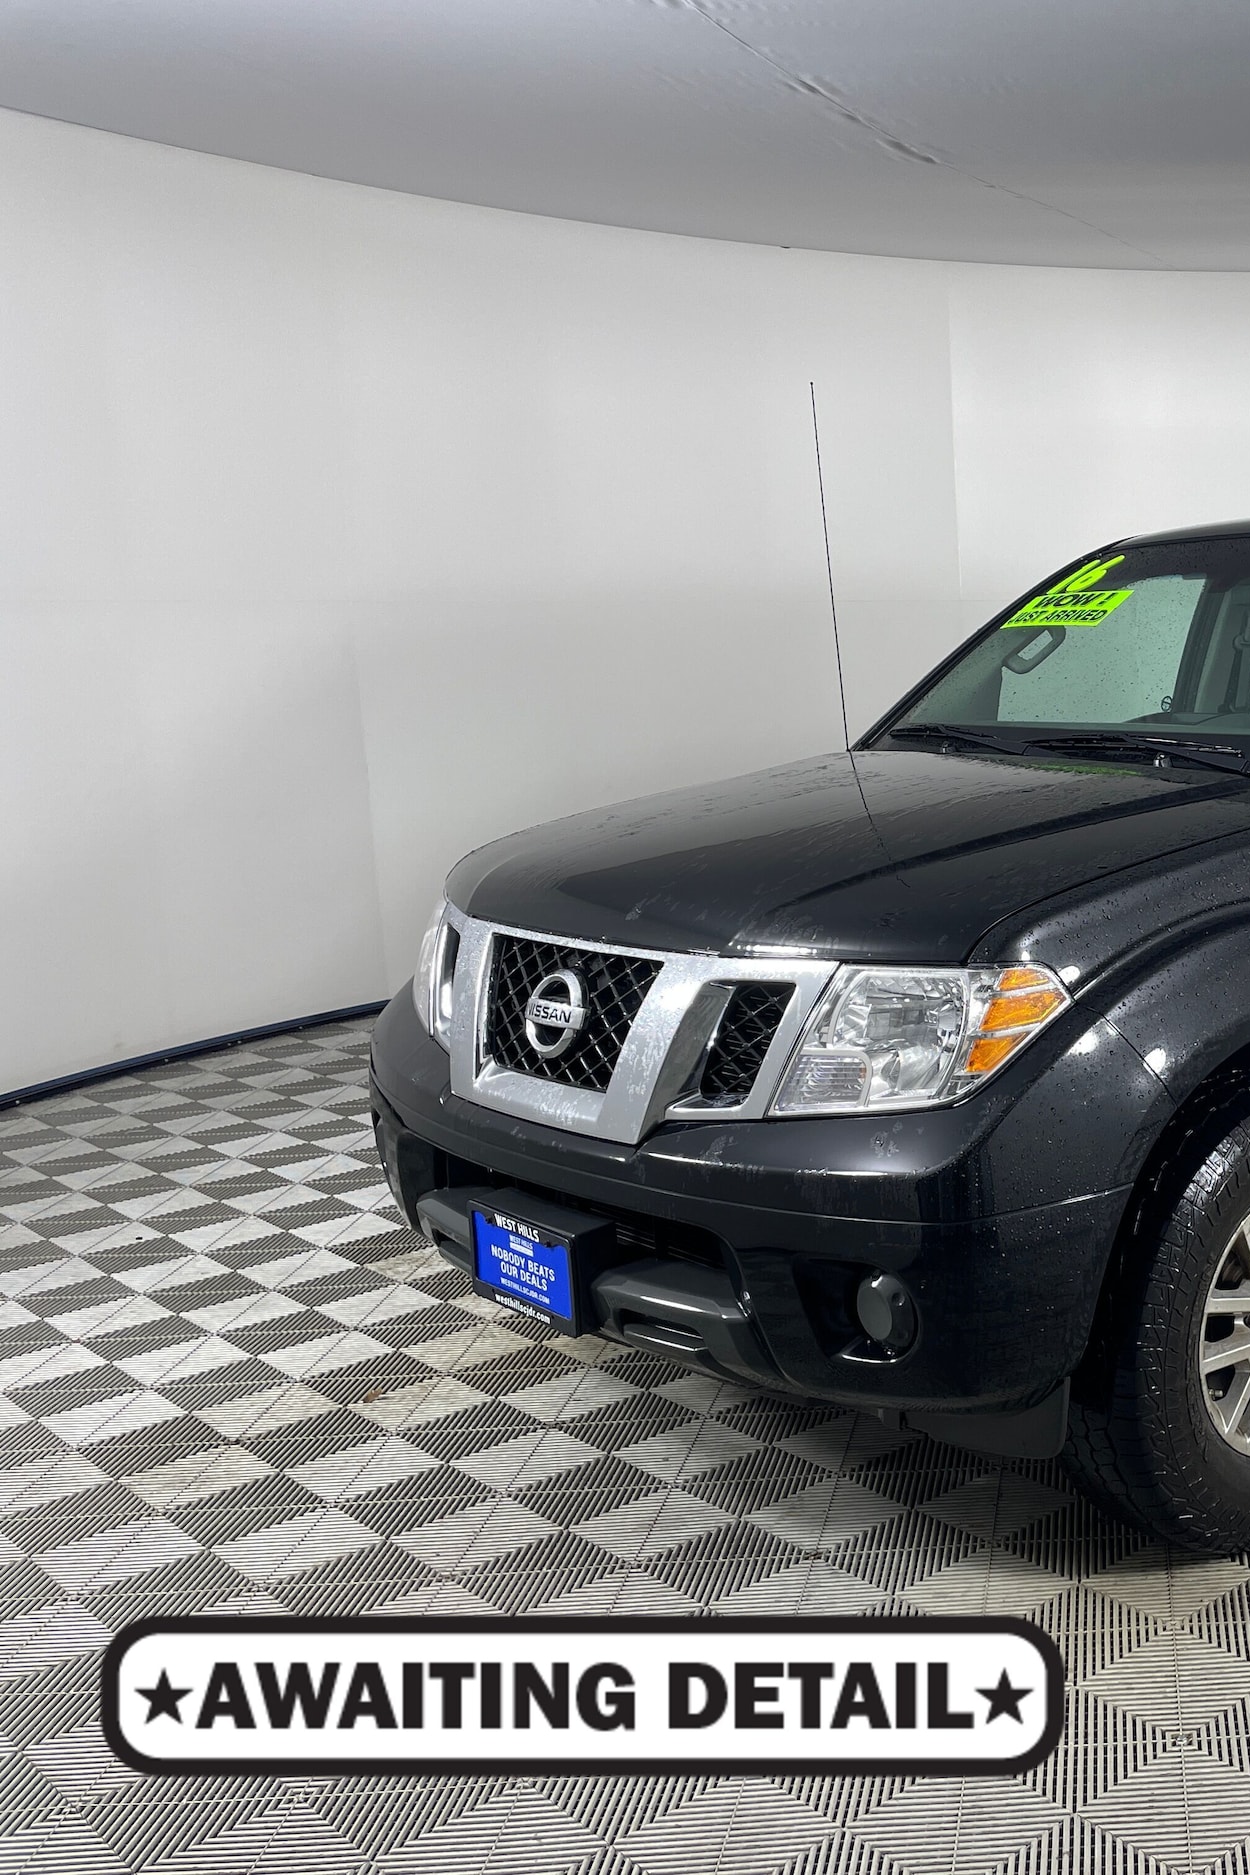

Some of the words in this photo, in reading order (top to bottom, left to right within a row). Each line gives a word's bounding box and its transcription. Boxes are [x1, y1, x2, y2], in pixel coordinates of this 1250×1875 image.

[1046, 554, 1126, 595] 16
[1007, 610, 1050, 625] JUST
[1041, 609, 1108, 622] ARRIVED
[528, 1003, 572, 1024] NISSAN
[494, 1213, 516, 1232] WEST
[516, 1222, 540, 1243] HILLS
[509, 1234, 521, 1246] WEST
[491, 1244, 526, 1269] NOBODY
[527, 1259, 555, 1282] BEATS
[500, 1261, 519, 1279] OUR
[520, 1269, 548, 1291] DEALS
[494, 1293, 551, 1324] westhillscjdr.com
